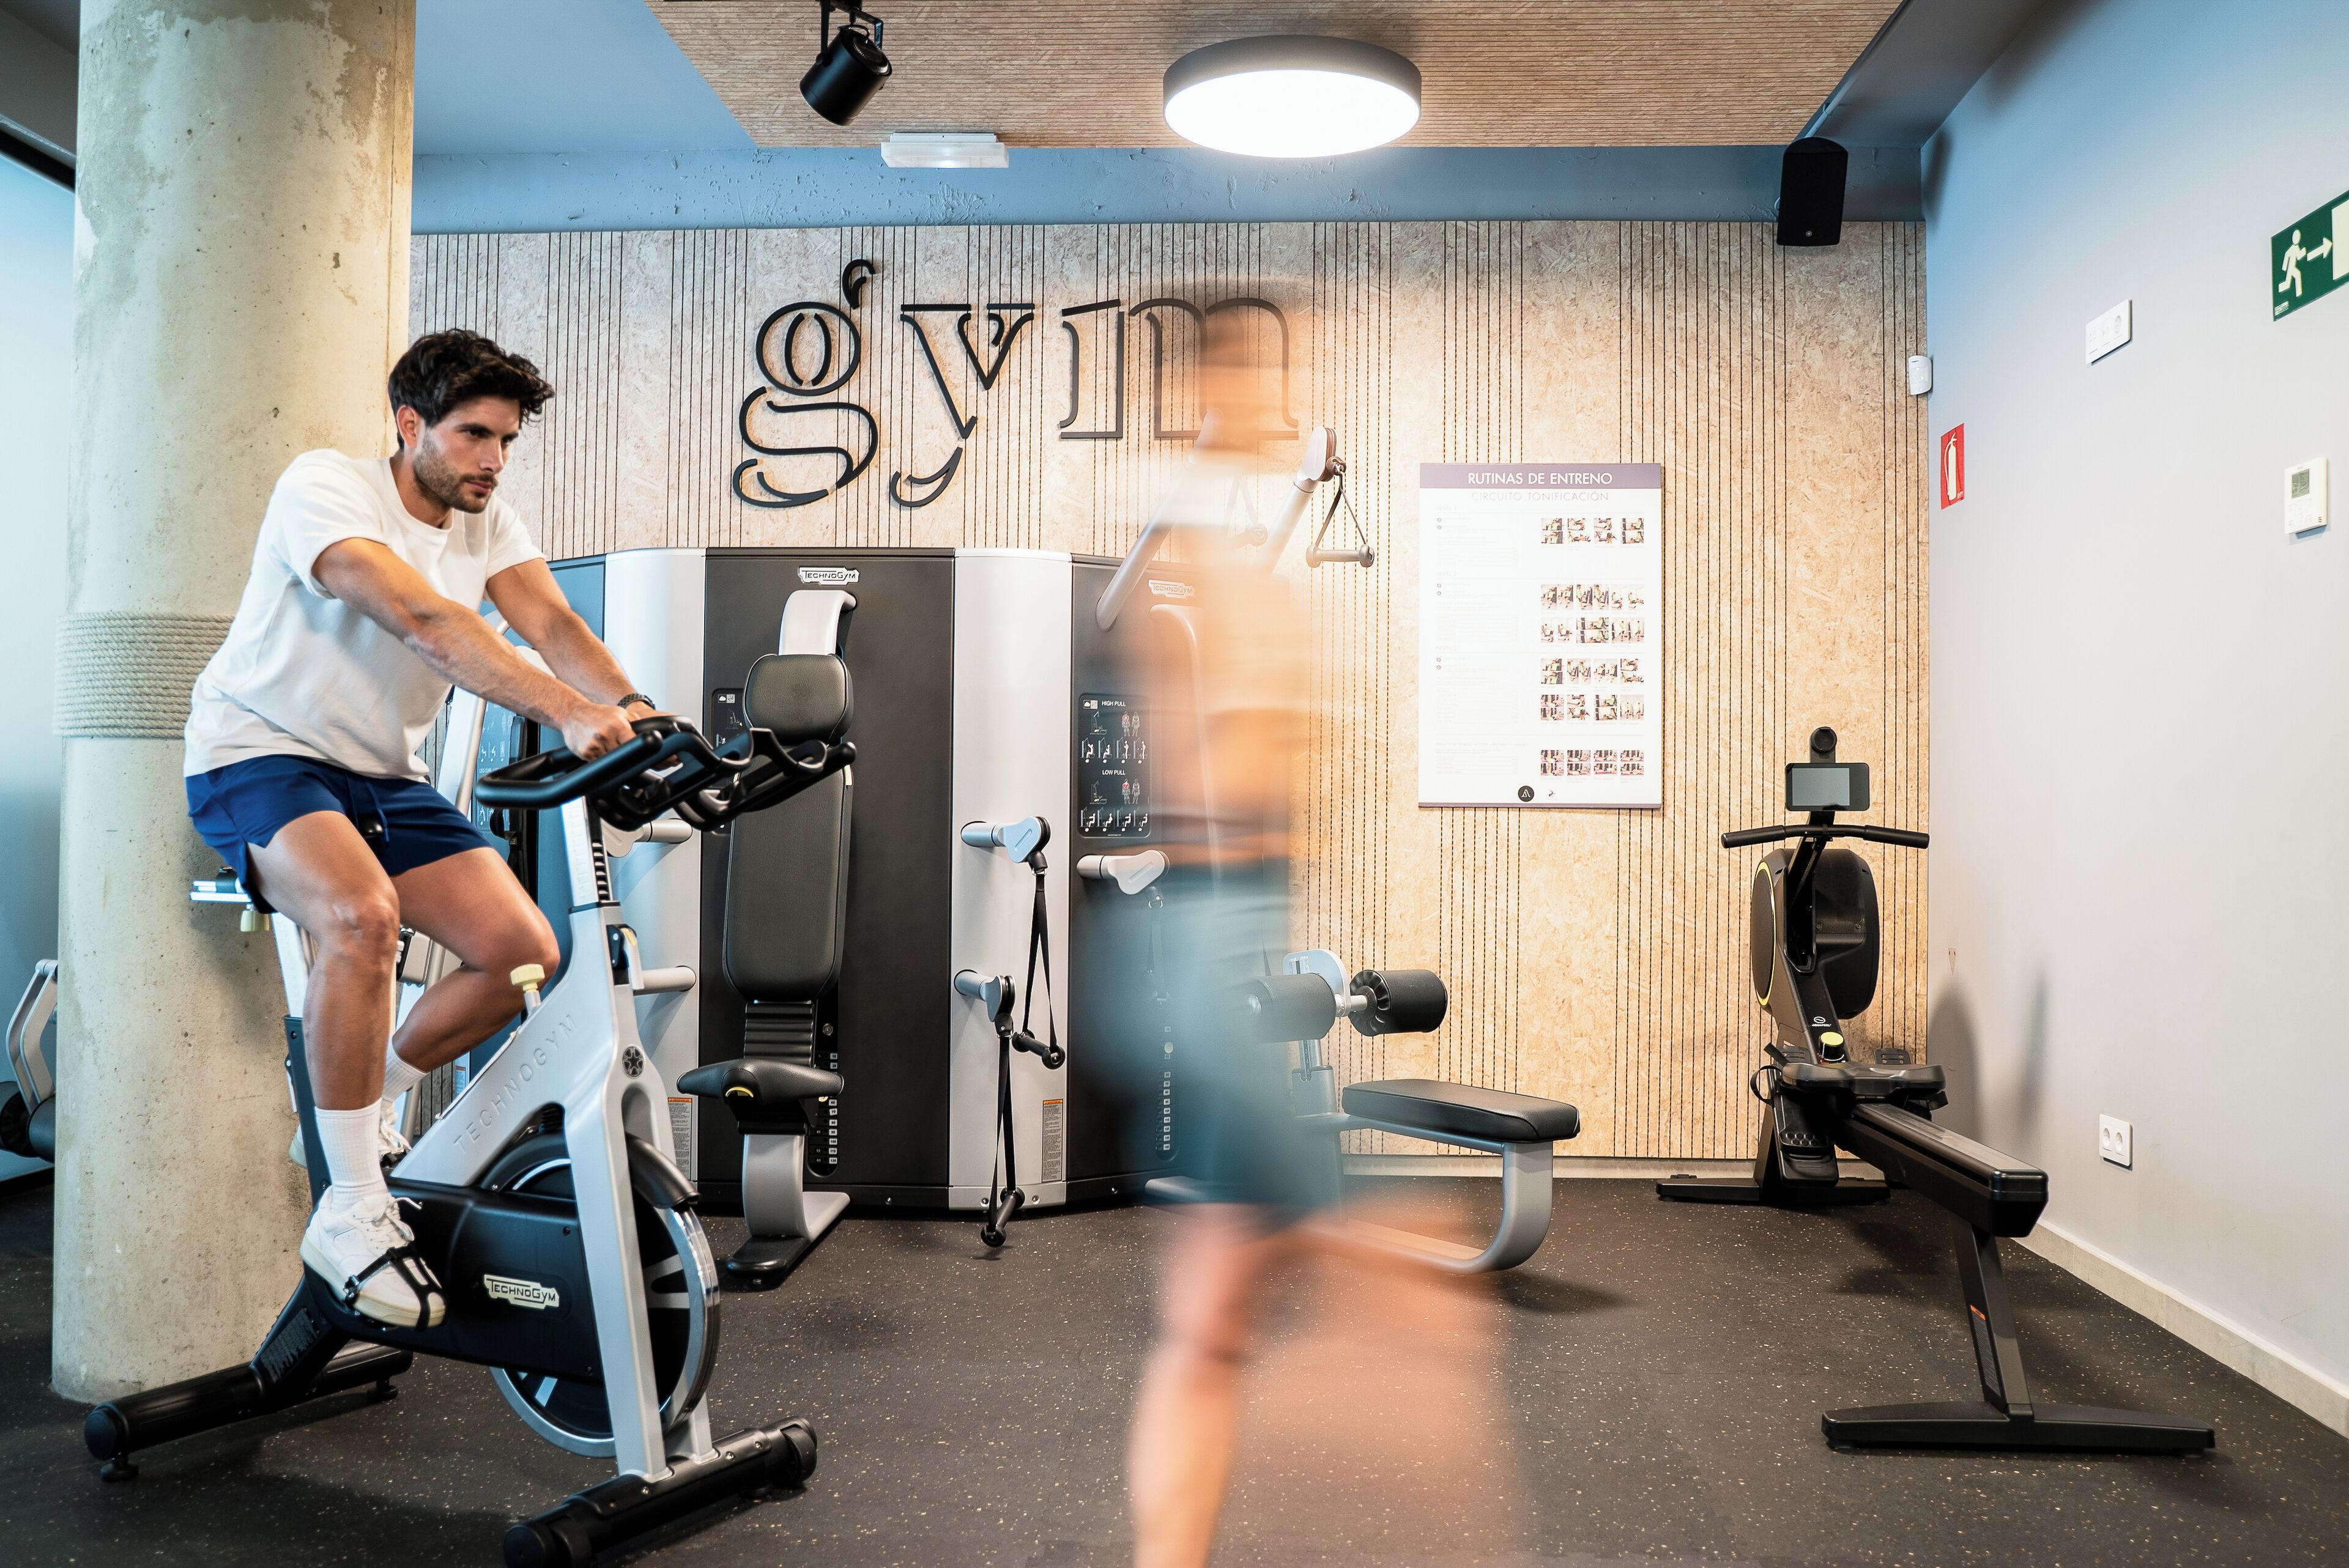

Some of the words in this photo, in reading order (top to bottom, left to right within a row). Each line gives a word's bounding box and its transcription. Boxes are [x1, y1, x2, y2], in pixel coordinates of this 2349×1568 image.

[733, 259, 1298, 507] gym
[1468, 472, 1523, 484] RUTINAS
[1528, 472, 1545, 484] DE
[1550, 472, 1613, 485] ENTRENO
[1472, 492, 1522, 501] CIRCUITO
[1527, 490, 1609, 501] TONIFICACIÓN
[453, 1014, 576, 1155] TECHNOGYM
